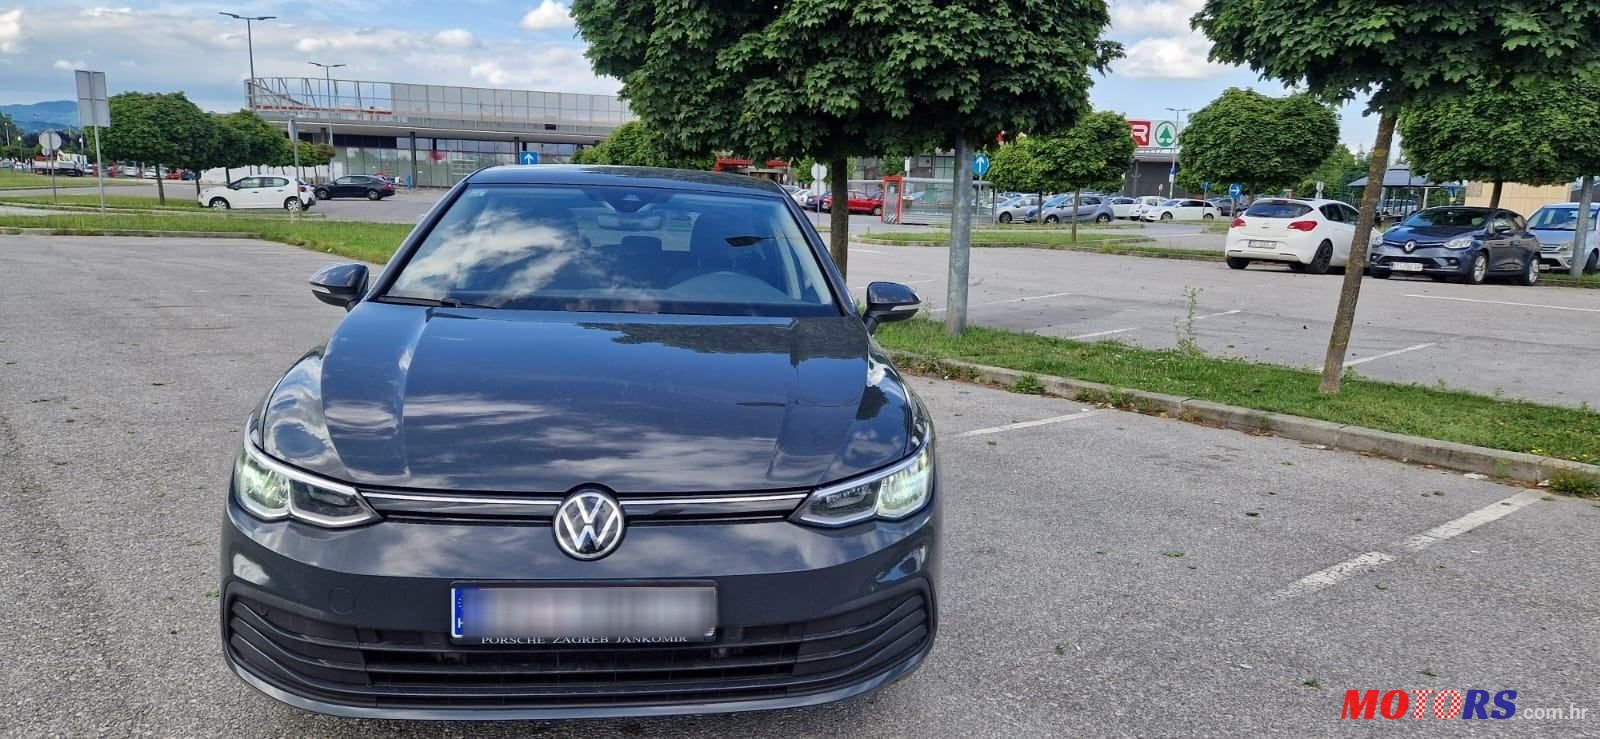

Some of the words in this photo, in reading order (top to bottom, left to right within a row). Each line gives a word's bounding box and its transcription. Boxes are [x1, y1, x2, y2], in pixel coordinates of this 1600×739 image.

[556, 493, 621, 554] VW
[481, 635, 546, 645] PORSCHE
[552, 635, 609, 645] ZAGREB
[615, 634, 688, 644] JANKOMIR
